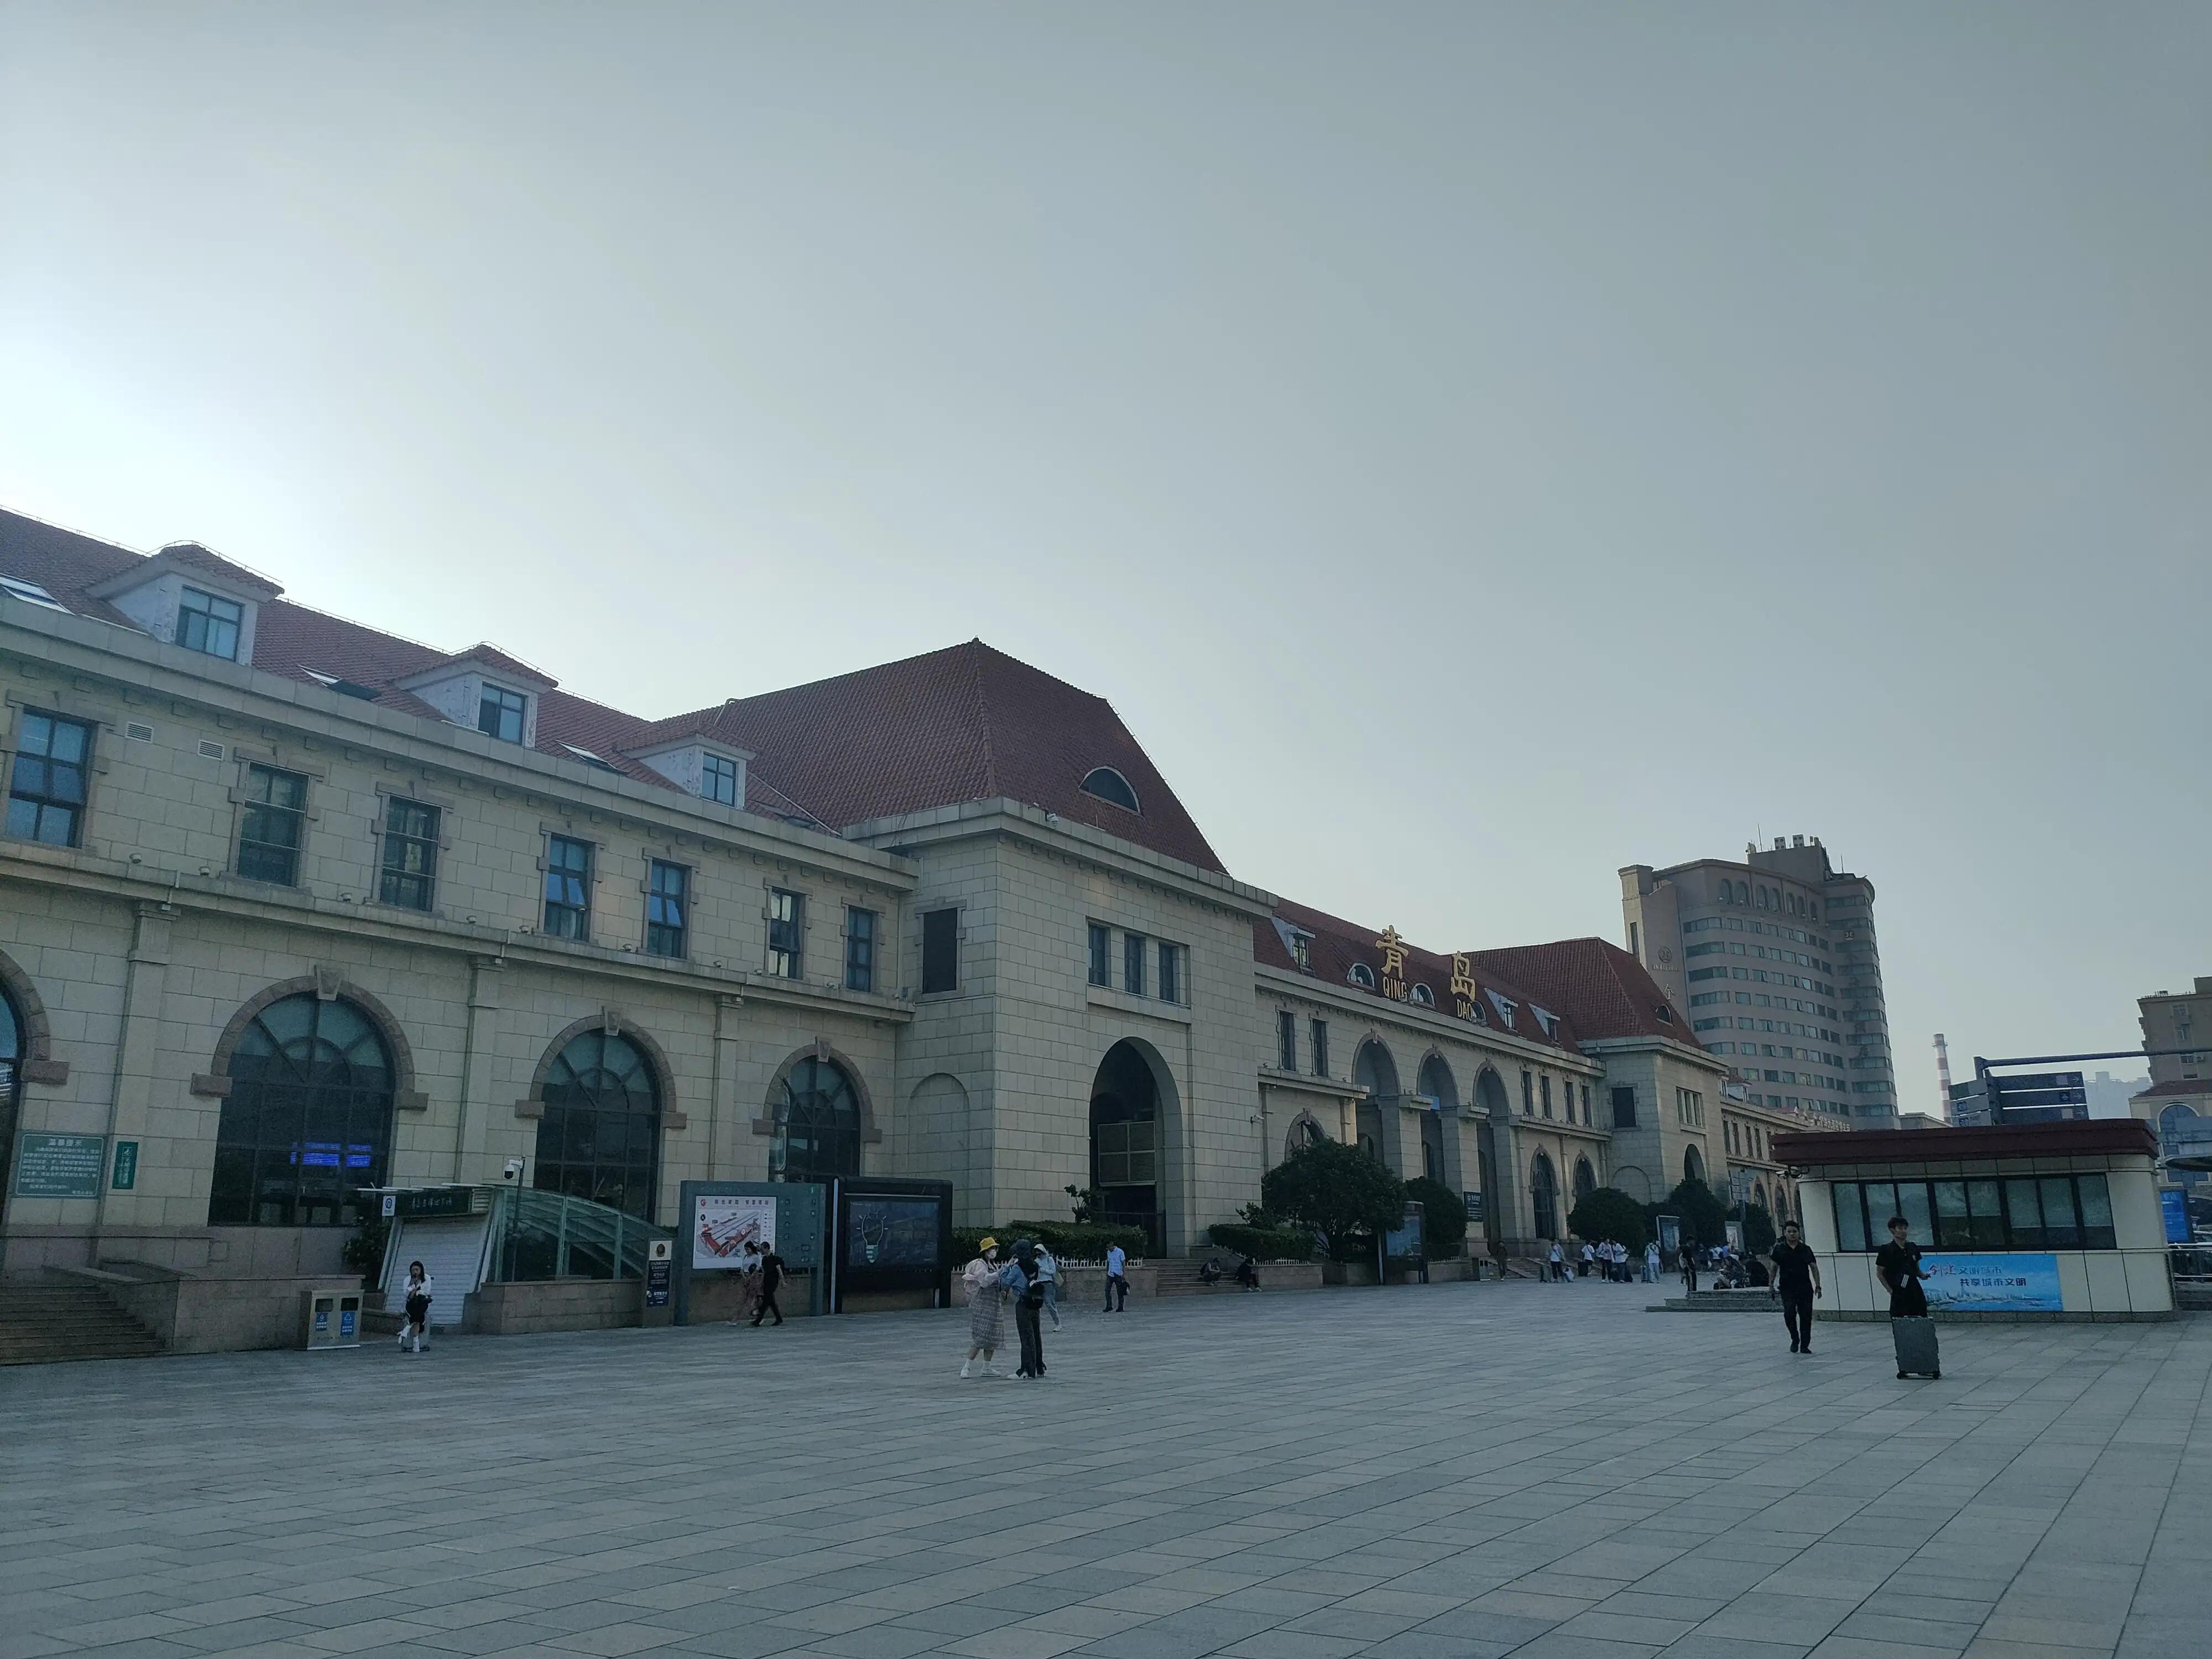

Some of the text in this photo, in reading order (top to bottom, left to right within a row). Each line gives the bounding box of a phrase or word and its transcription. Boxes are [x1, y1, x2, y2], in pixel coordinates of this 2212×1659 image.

[1383, 975, 1408, 1003] QING
[1457, 998, 1473, 1022] DAO
[1960, 1277, 2026, 1287] 共享城市文明
